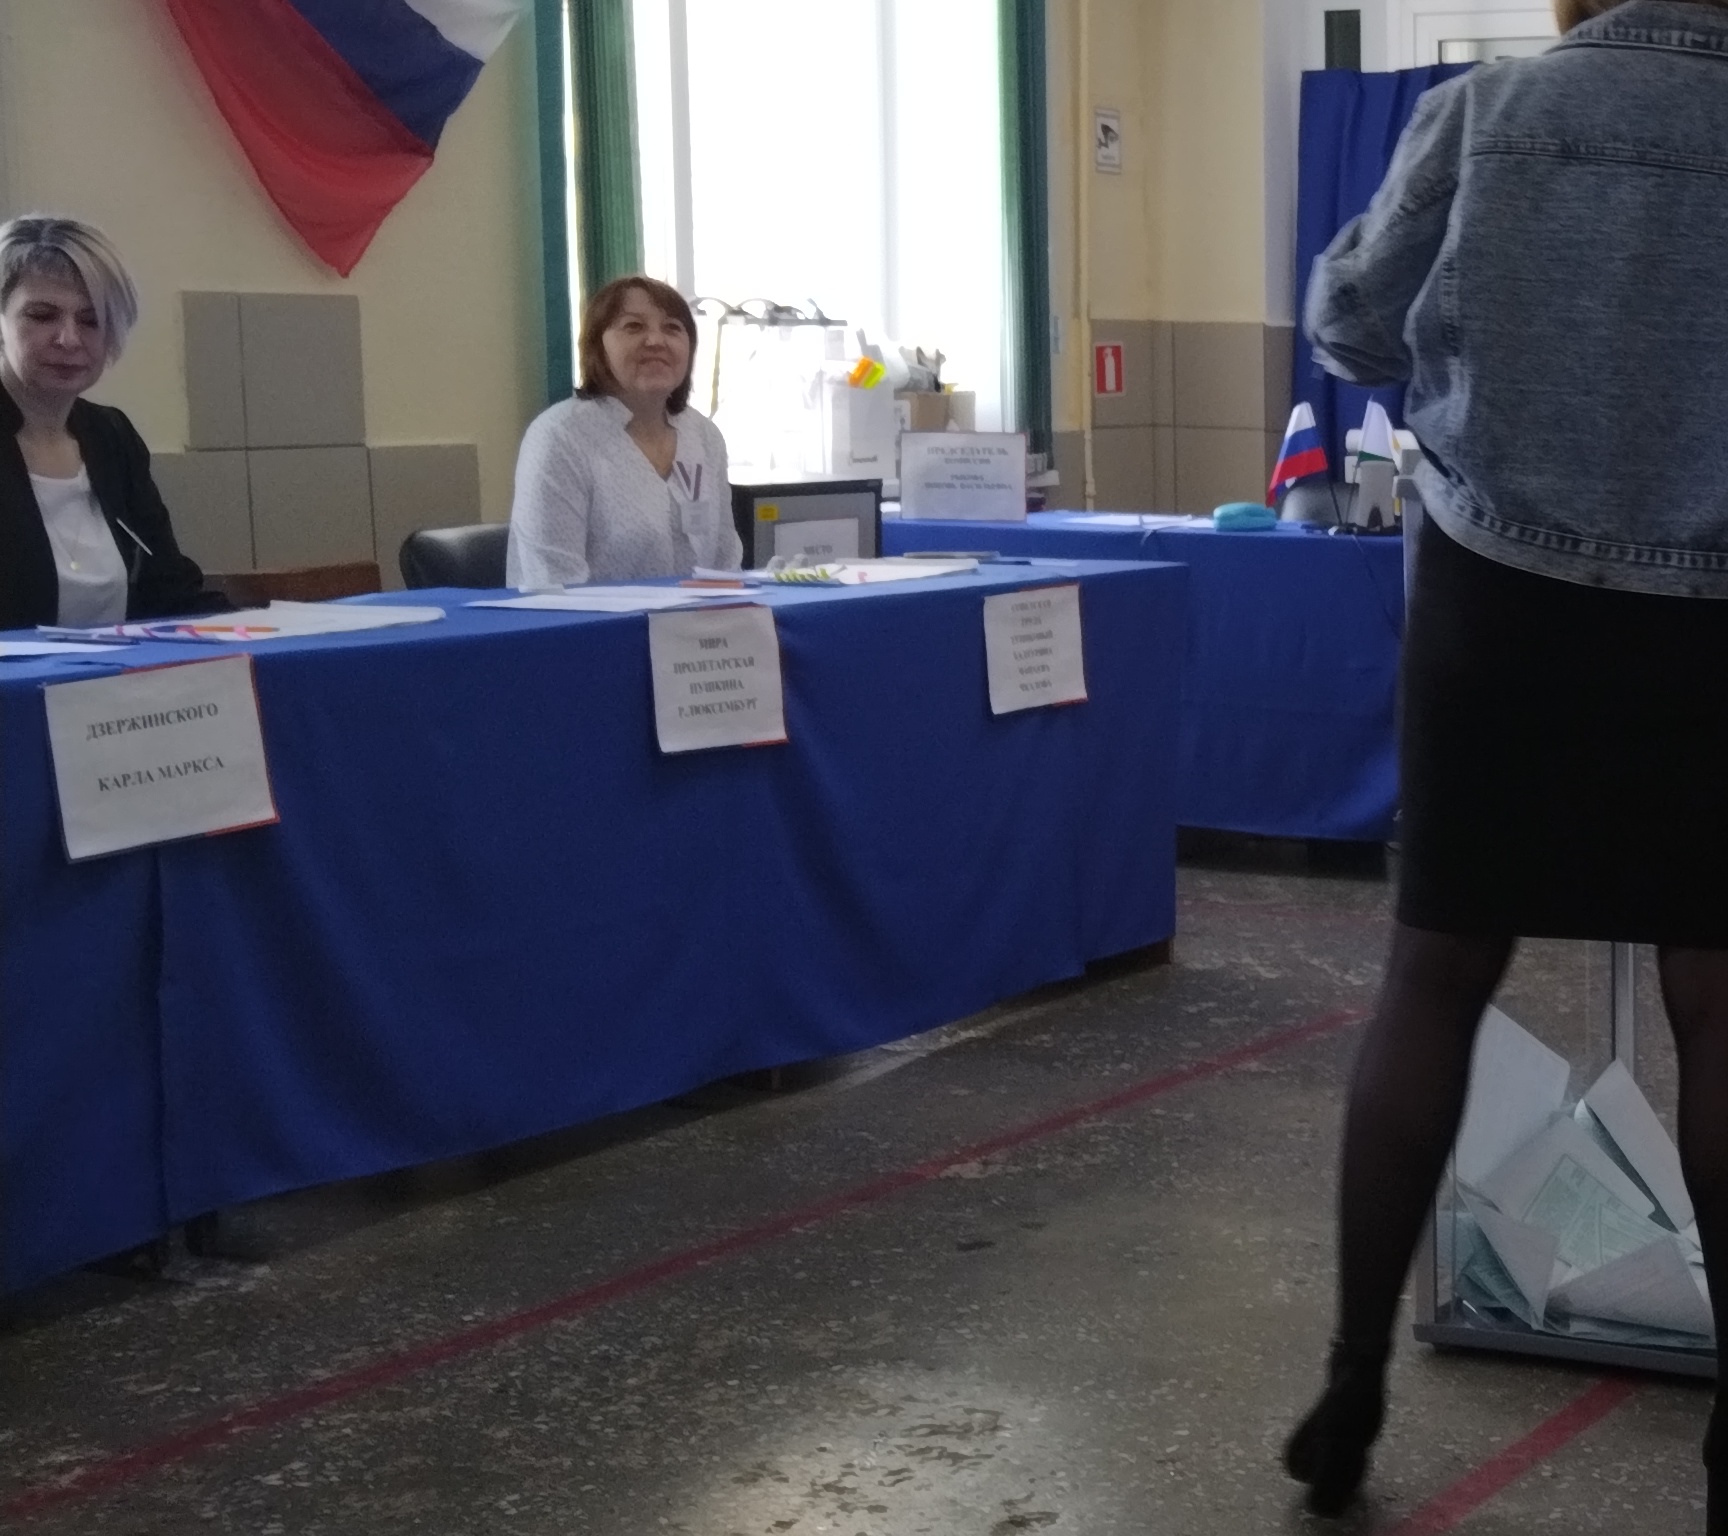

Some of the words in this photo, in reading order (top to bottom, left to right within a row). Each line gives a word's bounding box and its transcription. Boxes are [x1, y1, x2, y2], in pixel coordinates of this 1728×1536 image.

[672, 656, 755, 674] ПРОЛЕТАРСКАЯ
[689, 679, 745, 694] ПУШКИНА
[85, 702, 219, 741] ДЗЕРЖИНСКОГО
[97, 769, 155, 792] КАРЛА
[158, 756, 225, 779] МАРКСА
